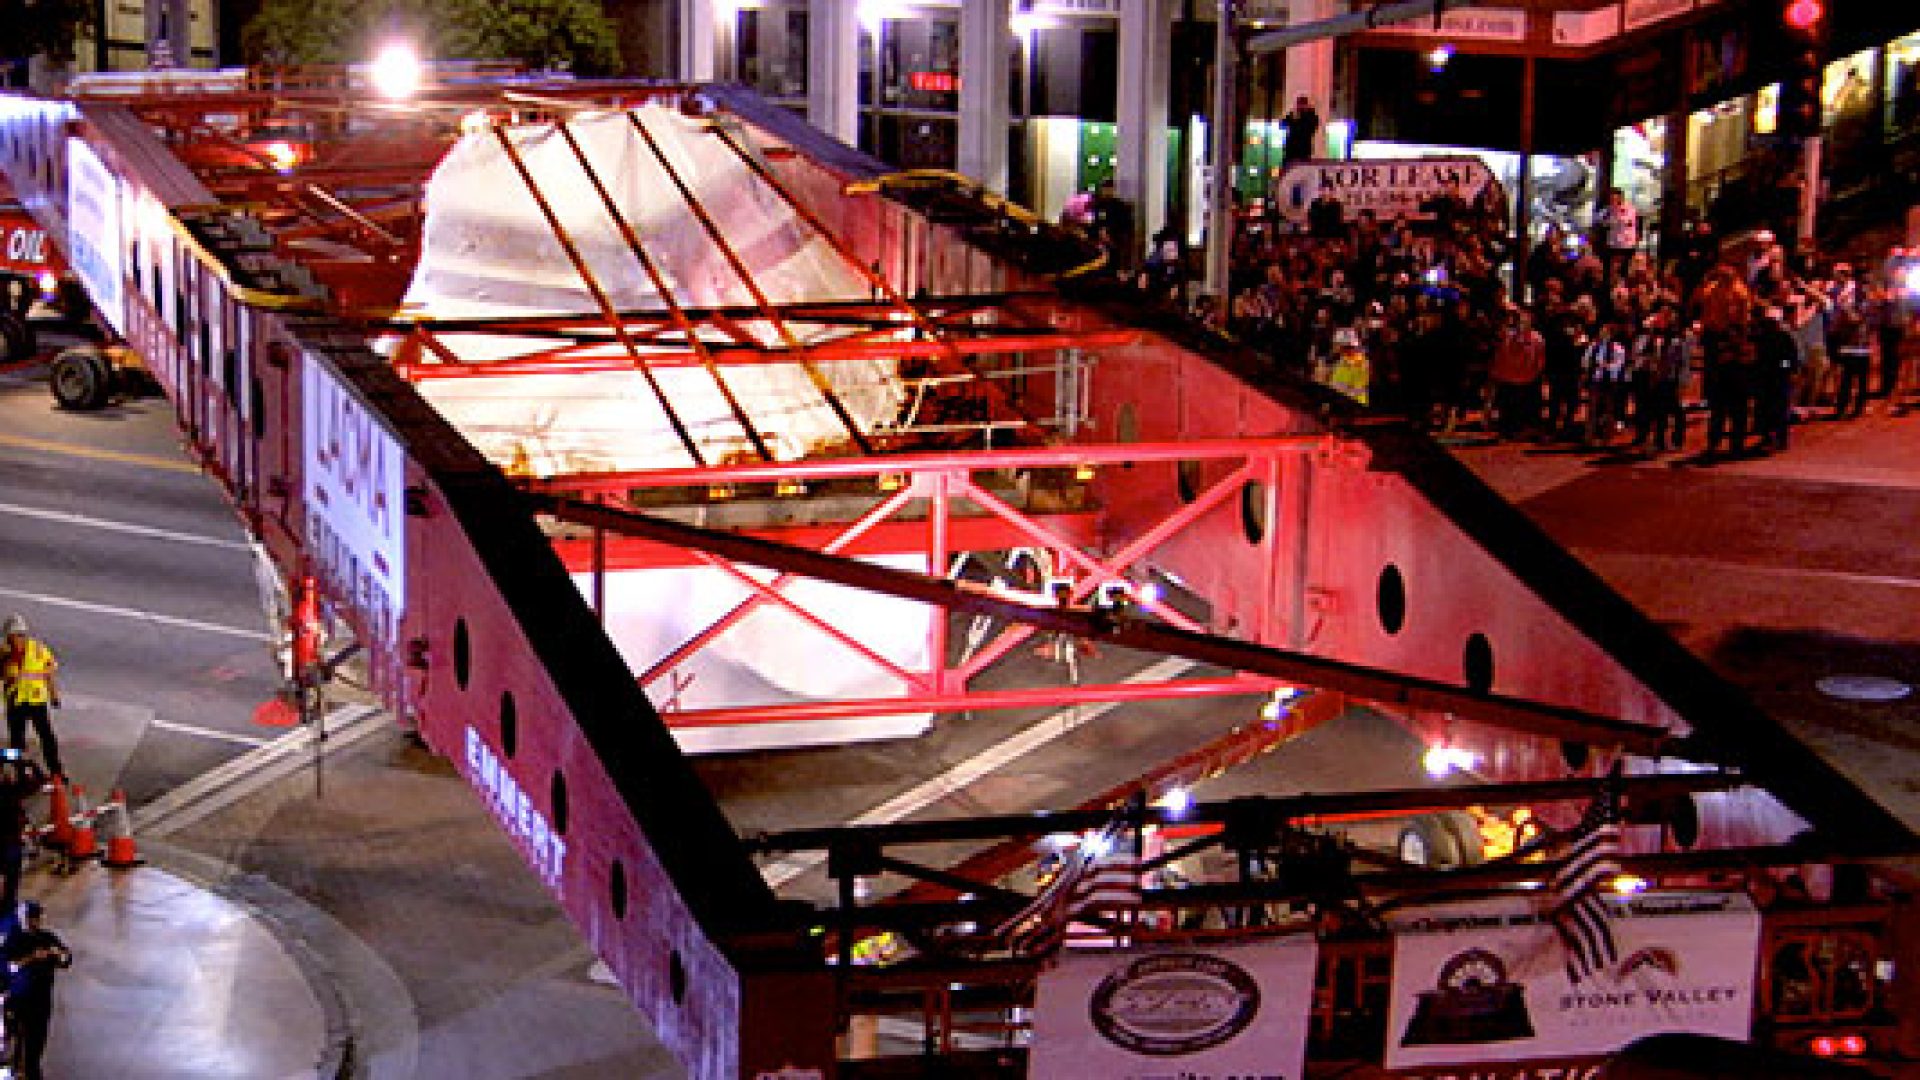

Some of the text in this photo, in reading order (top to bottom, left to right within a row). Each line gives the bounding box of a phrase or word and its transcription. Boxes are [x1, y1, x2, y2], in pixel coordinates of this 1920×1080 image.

[1317, 164, 1478, 190] FOR LEASE
[9, 228, 47, 264] OIL
[464, 725, 567, 884] EMMERT
[1559, 987, 1737, 1011] STONE VALLEY
